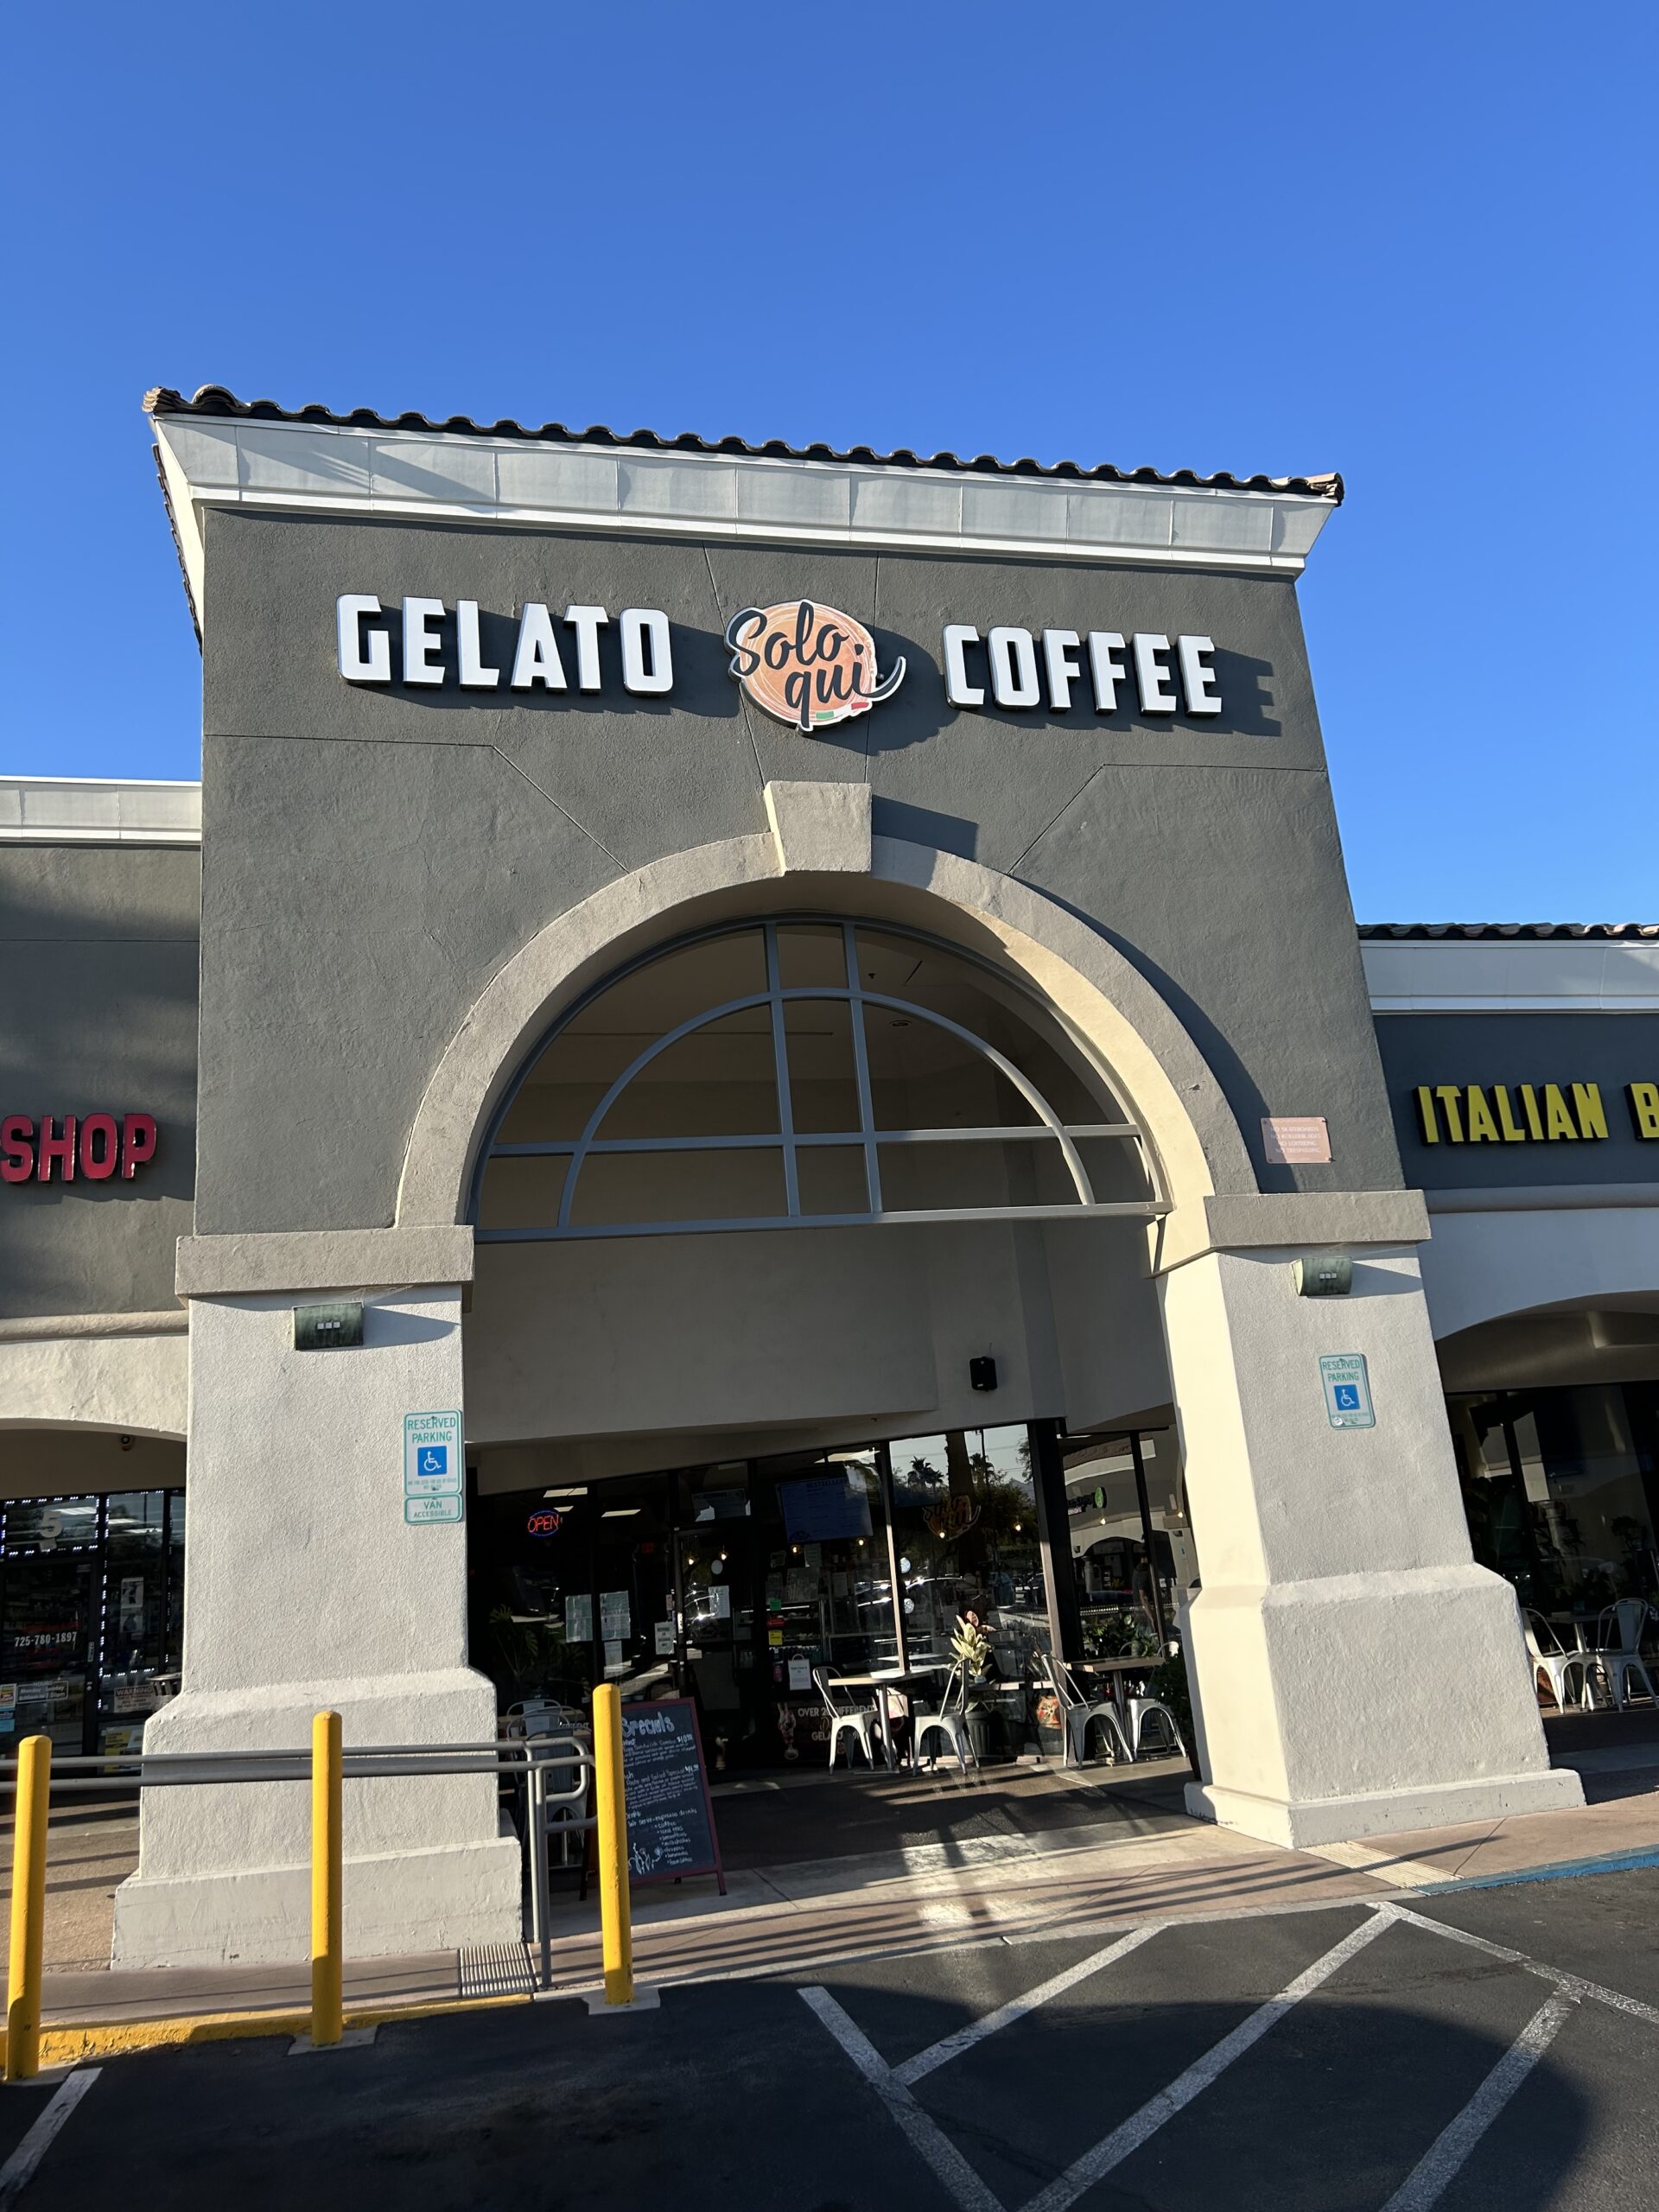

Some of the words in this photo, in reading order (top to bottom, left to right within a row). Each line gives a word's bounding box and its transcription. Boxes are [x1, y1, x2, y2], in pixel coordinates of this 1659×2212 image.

[337, 594, 673, 696] GELATO
[729, 601, 849, 677] Solo
[943, 624, 1222, 717] COFFEE
[785, 644, 905, 728] qui
[1414, 1083, 1609, 1144] ITALIAN
[1624, 1083, 1659, 1141] B
[0, 1113, 156, 1183] SHOP
[1322, 1359, 1361, 1370] RESERVED
[1327, 1371, 1359, 1382] PARKING
[407, 1417, 456, 1431] RESERVED
[411, 1431, 453, 1444] PARKING
[423, 1501, 442, 1510] VAN
[413, 1510, 452, 1518] ACCESSIBLE
[527, 1514, 559, 1534] OPEN
[15, 1630, 77, 1647] 725-780-1897
[116, 1687, 153, 1696] WARNING
[798, 1707, 819, 1717] OVER
